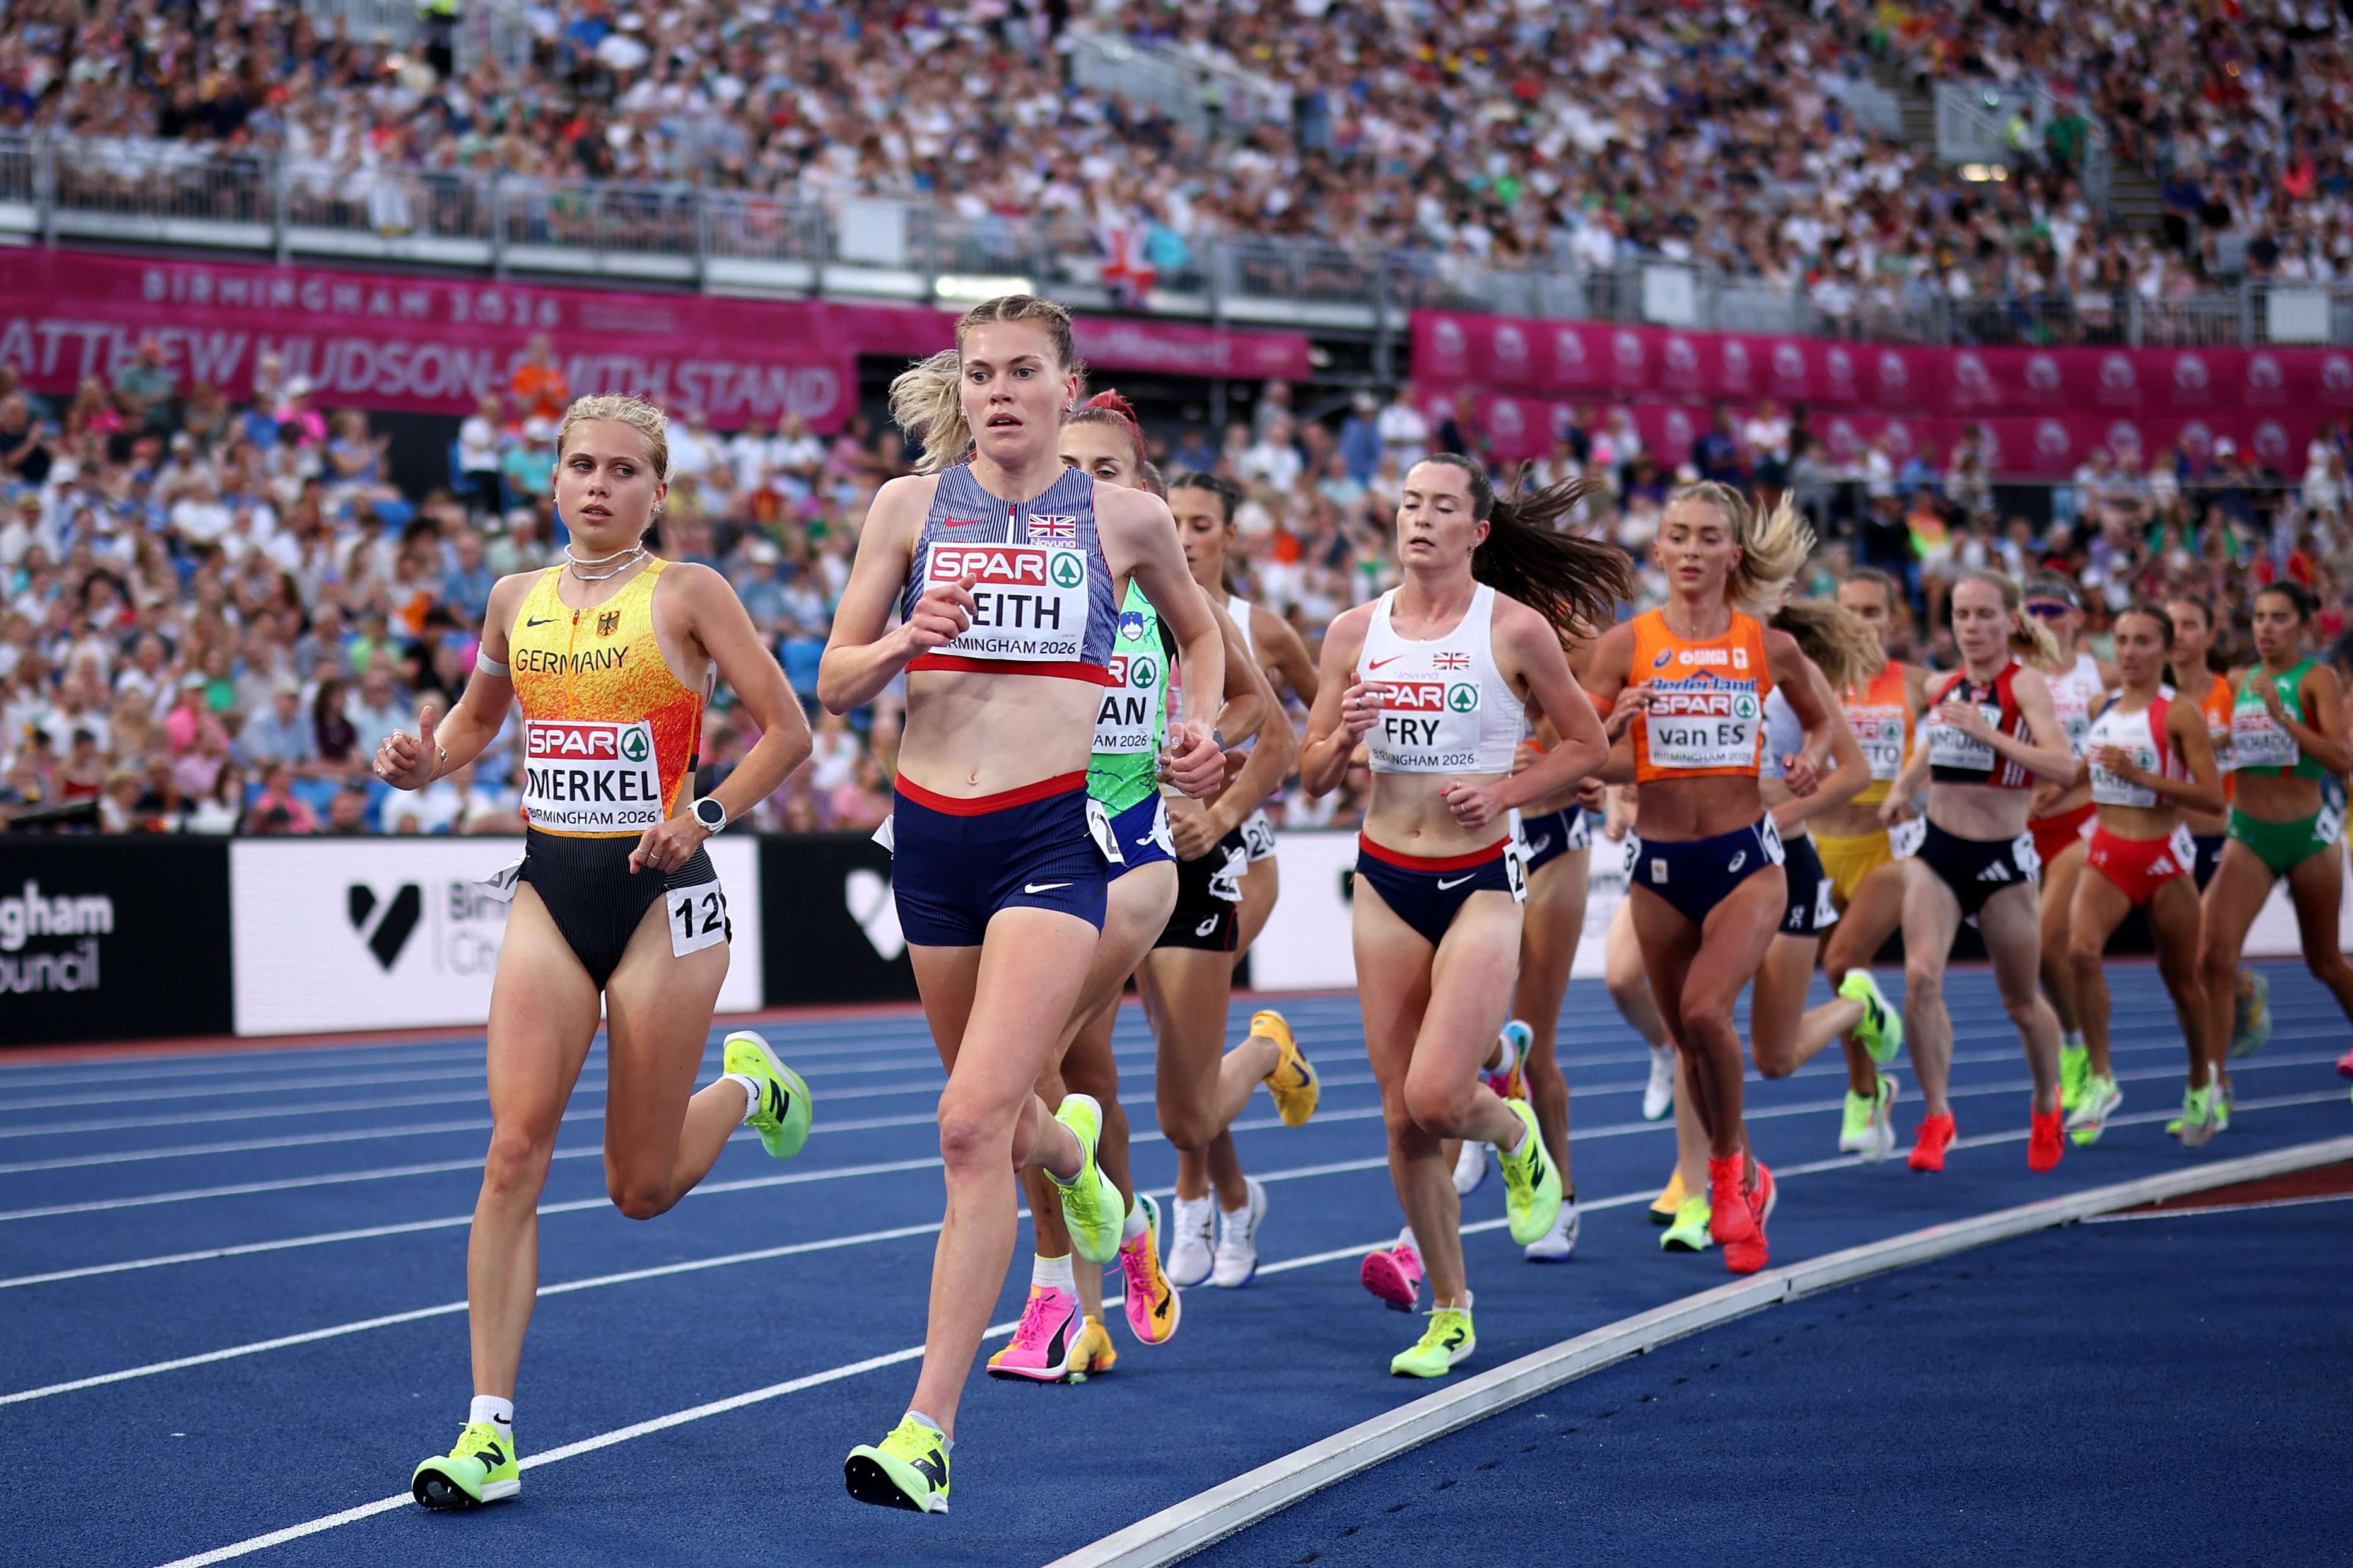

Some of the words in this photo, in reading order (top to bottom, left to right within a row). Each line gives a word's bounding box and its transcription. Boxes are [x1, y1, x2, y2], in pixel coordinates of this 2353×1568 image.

[143, 269, 431, 318] BIRMINGHAM
[448, 287, 561, 328] 2026
[0, 320, 248, 383] ATTHEW
[675, 357, 840, 419] STAND
[1031, 538, 1077, 549] Novuna
[934, 552, 1044, 581] SPAR
[972, 593, 1061, 630] EITH
[949, 637, 1036, 654] RMINGHAM
[1041, 641, 1076, 654] 2026
[516, 646, 629, 675] GERMANY
[1393, 671, 1439, 680] Novuna
[1097, 696, 1147, 726] AN
[1650, 695, 1729, 714] SPAR
[530, 729, 616, 755] SPAR
[1120, 735, 1147, 746] 2026
[1385, 718, 1440, 746] FRY
[1659, 728, 1707, 746] van
[1718, 723, 1745, 746] ES
[1373, 748, 1439, 766] BIRMINGHAM
[1442, 753, 1474, 765] 2026
[1654, 752, 1726, 762] BIRMINGHAM
[527, 768, 658, 802] MERKEL
[530, 806, 613, 825] BIRMINGHAM
[618, 811, 656, 823] 2026
[675, 892, 722, 939] 12
